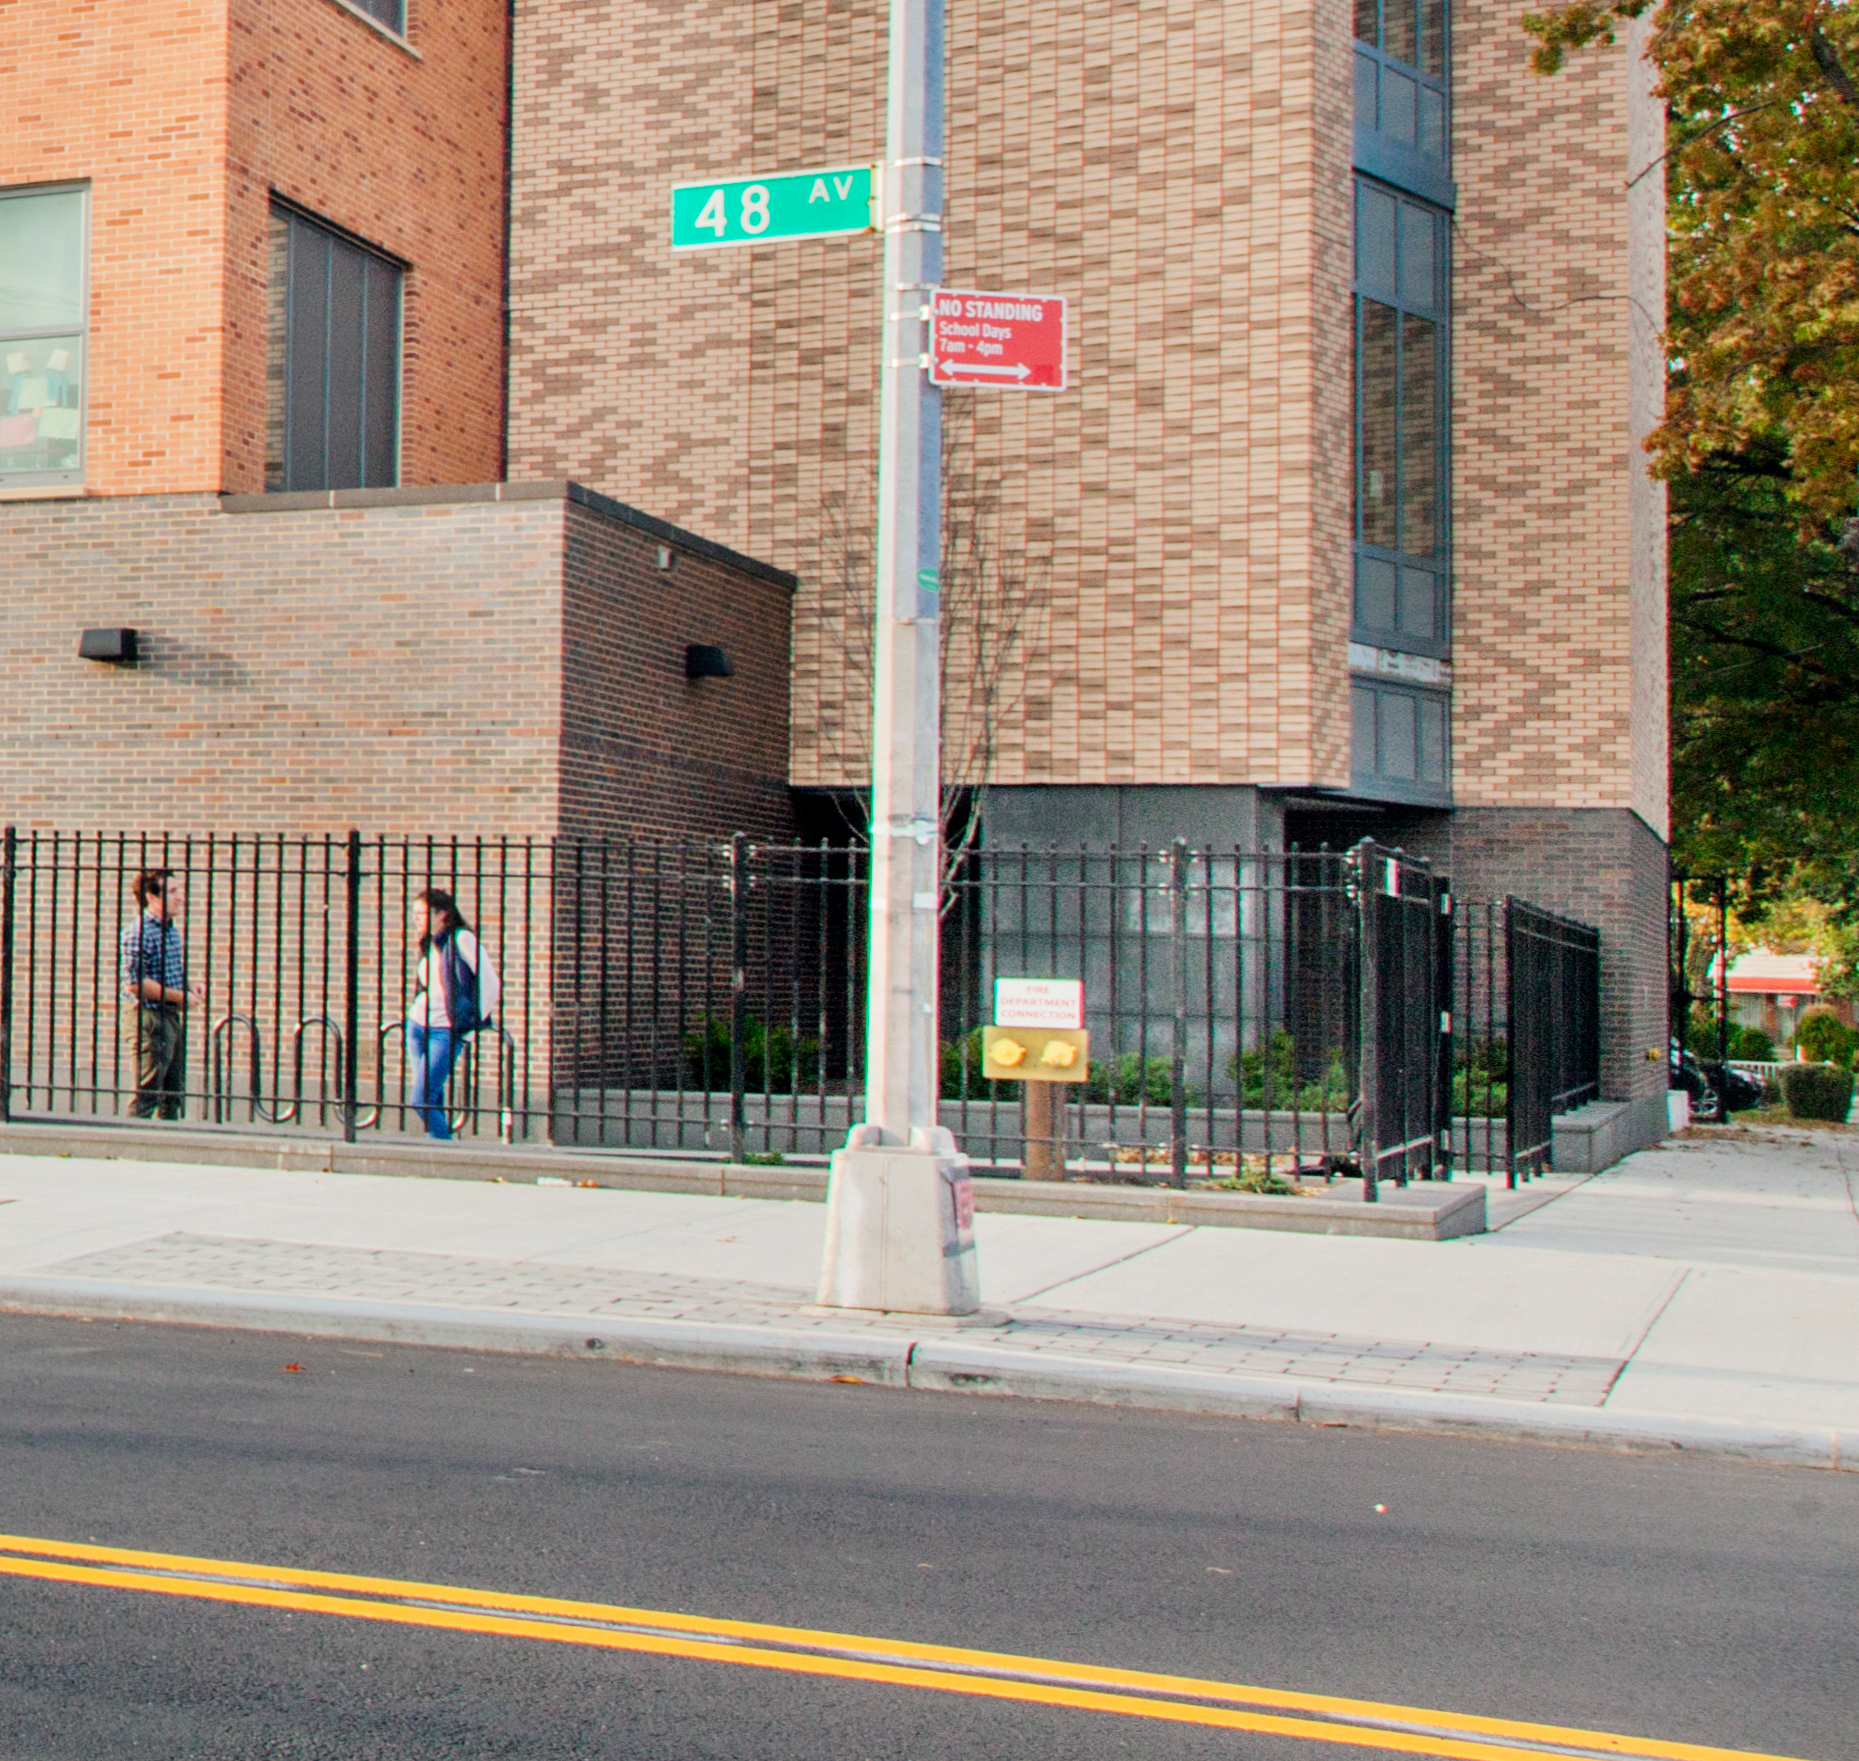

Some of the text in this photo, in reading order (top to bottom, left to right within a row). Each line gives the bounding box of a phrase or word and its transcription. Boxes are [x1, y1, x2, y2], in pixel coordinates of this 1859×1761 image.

[694, 175, 854, 237] 48 AV
[939, 299, 1043, 322] NO STANDING
[939, 321, 1012, 341] School Days
[939, 338, 965, 353] 7am
[976, 340, 1003, 357] 4pm
[1026, 986, 1049, 994] FIRE
[1000, 997, 1076, 1007] DEPARTMENT
[1000, 1009, 1075, 1019] CONNECTION
